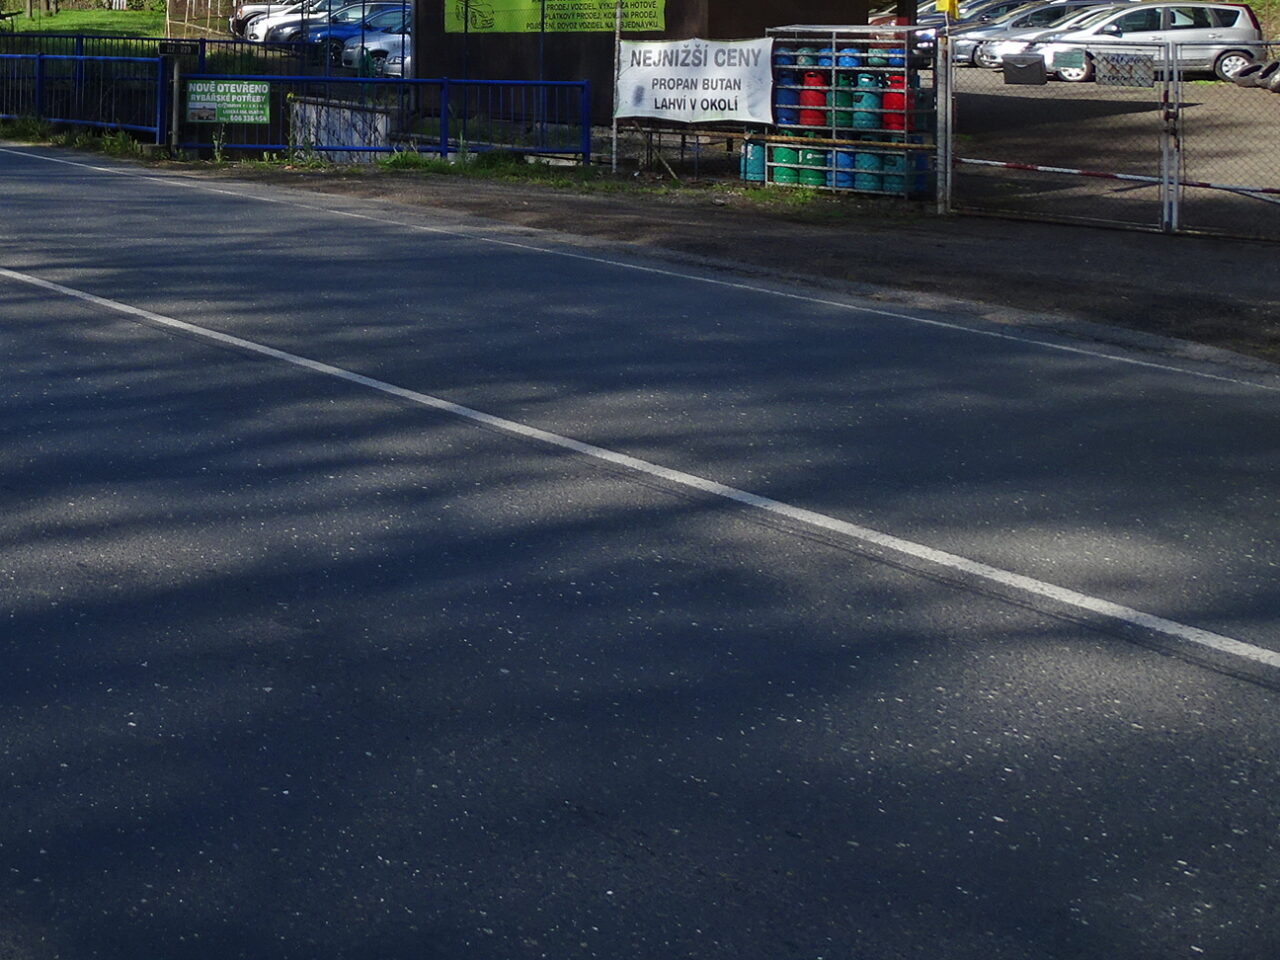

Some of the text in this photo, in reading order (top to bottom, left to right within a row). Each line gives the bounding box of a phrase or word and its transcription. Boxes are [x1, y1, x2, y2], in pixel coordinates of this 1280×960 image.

[547, 3, 569, 11] PRODEJ
[619, 20, 658, 29] BJEDNÁVKU
[630, 44, 762, 67] NEJNIŽŠÍ CENY
[188, 81, 269, 93] NOVĚ OTEVŘENO
[652, 78, 741, 91] PROPAN BUTAN
[191, 93, 266, 102] RYBÁŘSKÉ POTŘEBY
[654, 95, 738, 111] LAHVÍ V OKOLÍ
